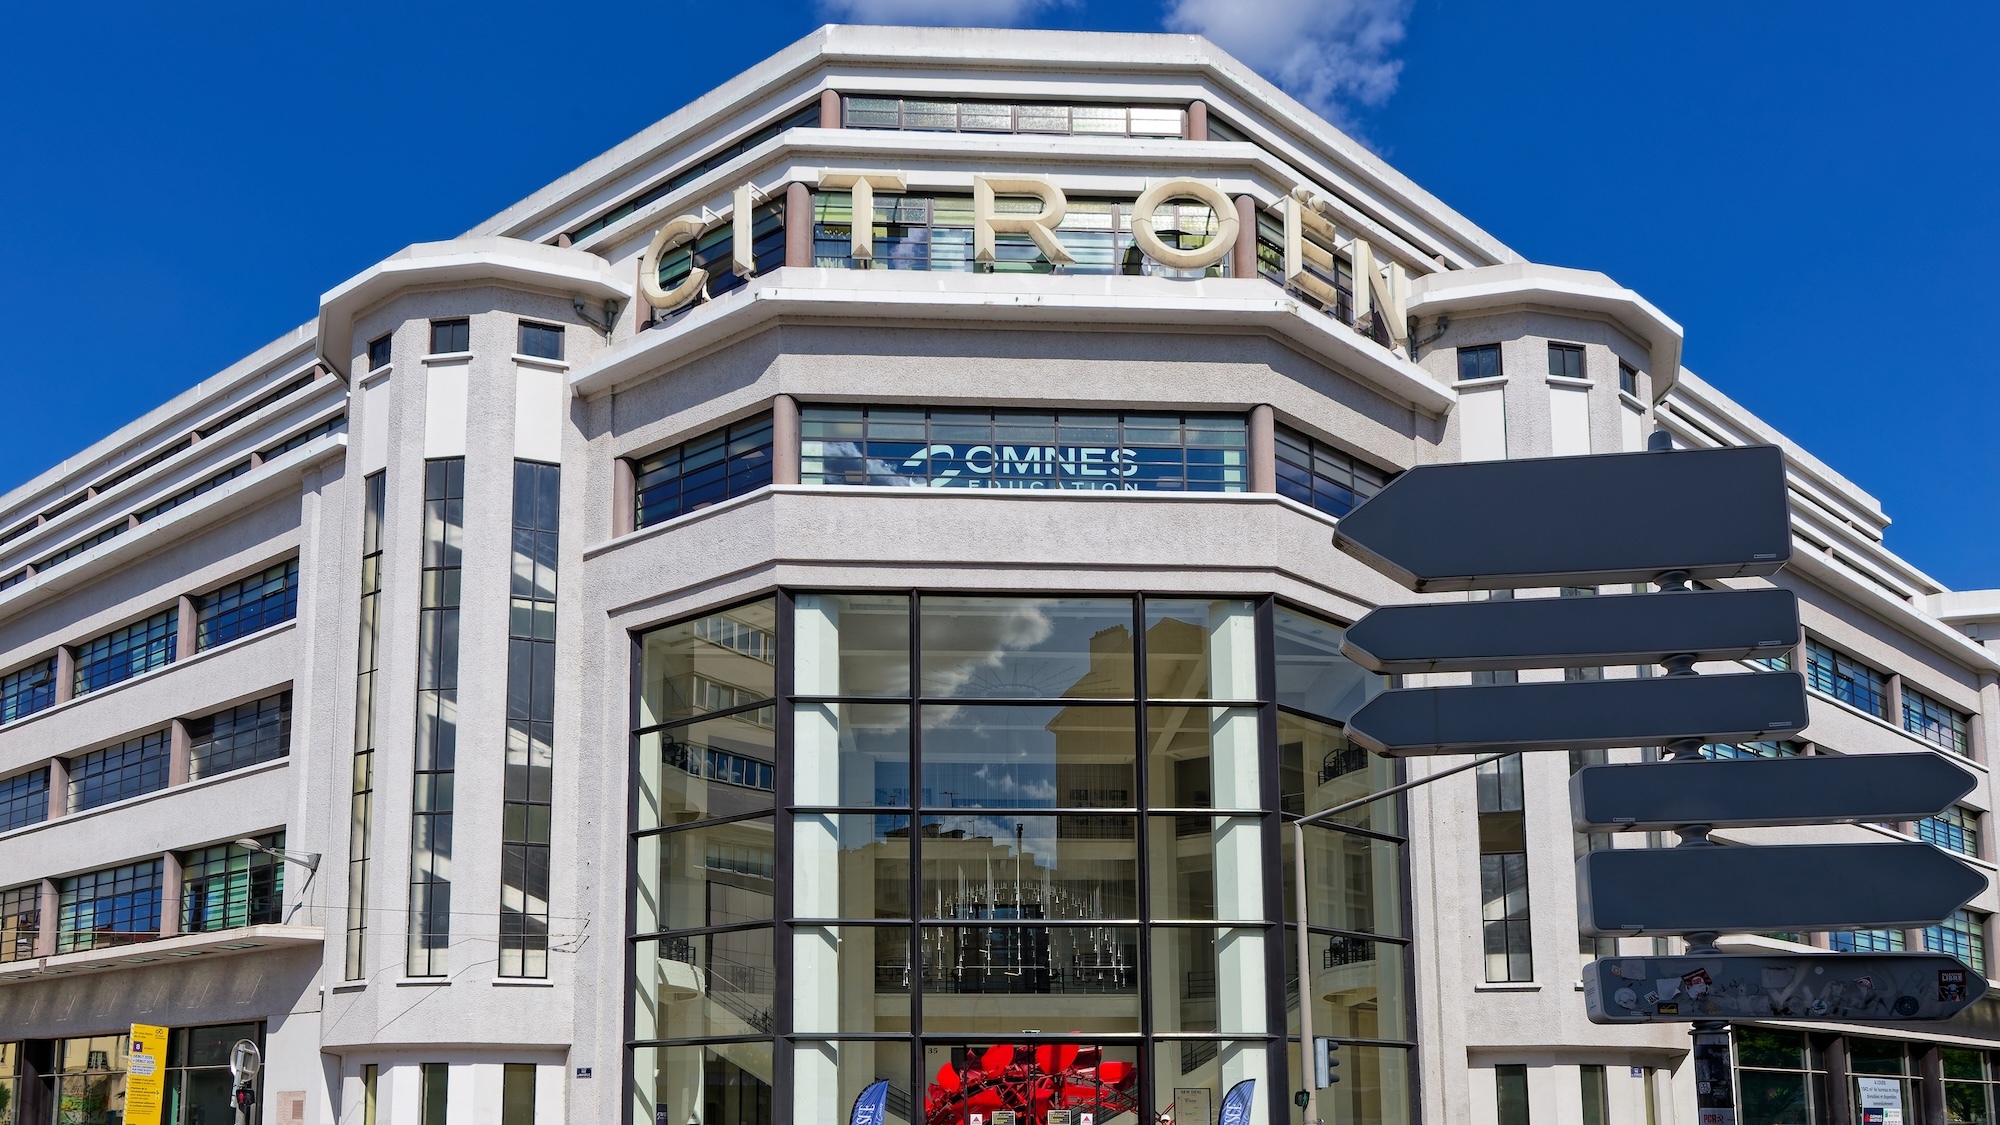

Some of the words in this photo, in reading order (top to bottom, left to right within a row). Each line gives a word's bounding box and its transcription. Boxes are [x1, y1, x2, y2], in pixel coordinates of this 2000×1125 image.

[640, 168, 1408, 347] CITROËN
[965, 445, 1139, 477] OMNES
[968, 480, 1139, 491] EDUCTION
[856, 1103, 876, 1125] SCE
